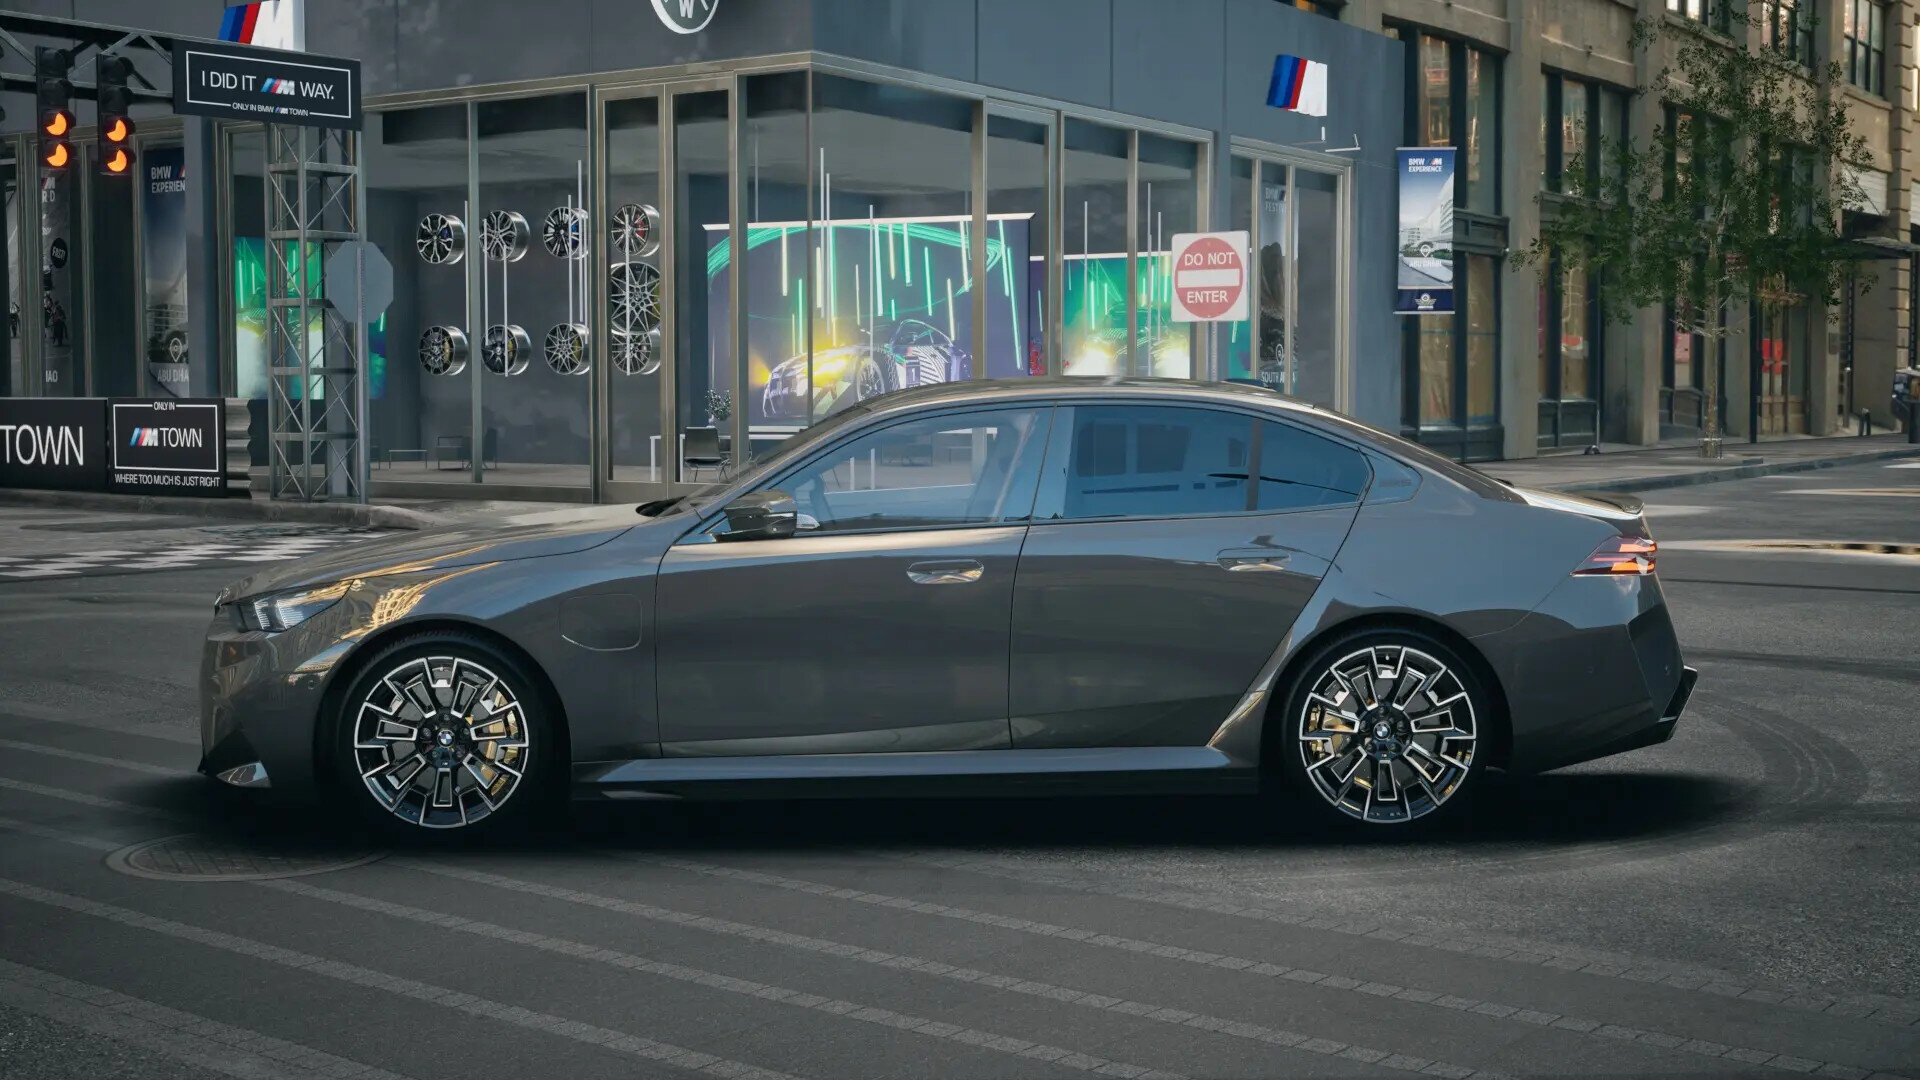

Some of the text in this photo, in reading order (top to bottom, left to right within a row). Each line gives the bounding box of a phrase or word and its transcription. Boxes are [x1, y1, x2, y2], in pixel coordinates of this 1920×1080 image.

[202, 70, 206, 86] I
[210, 71, 238, 89] DID
[242, 74, 257, 91] IT
[300, 81, 335, 100] WAY.
[232, 102, 250, 111] ONLY
[250, 103, 257, 111] IN
[257, 104, 275, 113] BMW
[289, 107, 309, 116] TOWN
[1409, 158, 1425, 166] BMW
[1409, 165, 1442, 173] EXPERIENCE
[151, 165, 171, 180] BMW
[151, 180, 186, 194] EXPERIEN
[1184, 251, 1235, 267] DO NOT
[1186, 290, 1229, 304] ENTER
[157, 369, 172, 382] ABU
[153, 401, 175, 411] ONLY IN
[160, 427, 202, 448] TOWN
[0, 424, 84, 466] TOWN
[114, 473, 220, 487] WHERE TOO MUCH IS JUST RIGHT
